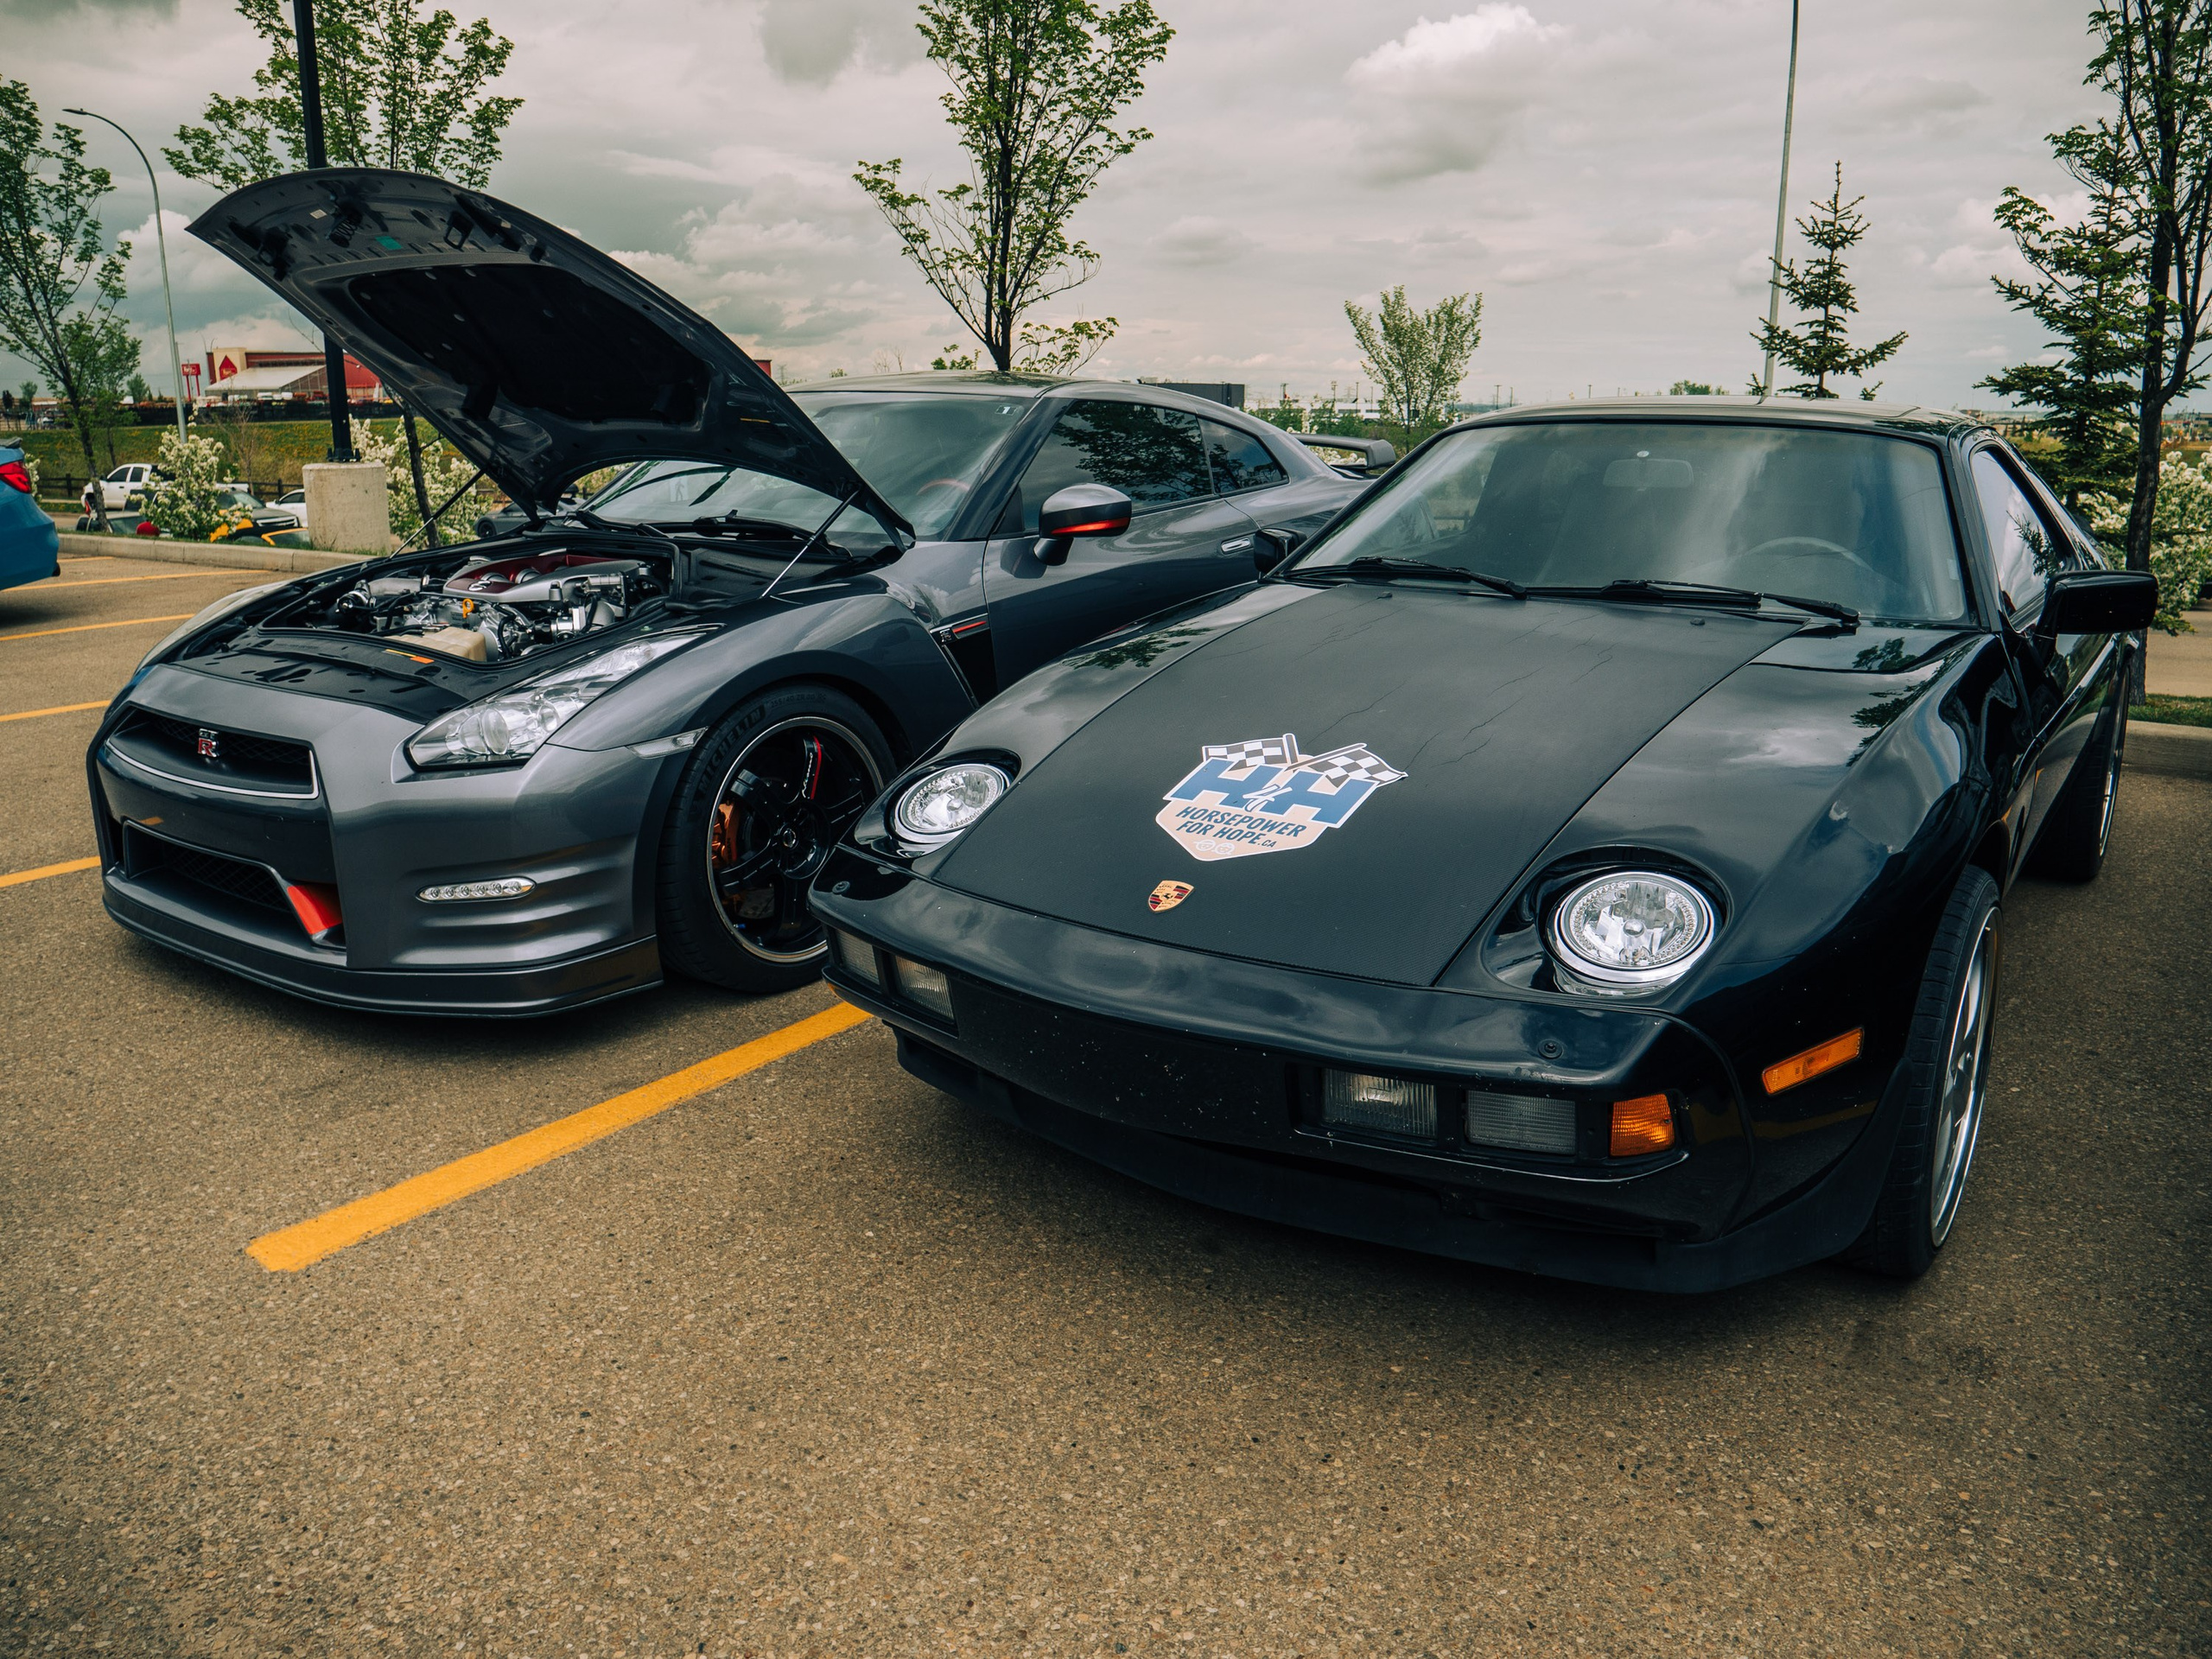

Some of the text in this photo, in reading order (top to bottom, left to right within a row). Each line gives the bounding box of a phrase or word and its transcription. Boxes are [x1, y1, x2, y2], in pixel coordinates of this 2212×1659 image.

[697, 704, 766, 795] MICHELIN
[1175, 805, 1307, 838] HORSEPOWER
[1176, 821, 1211, 836] FOR
